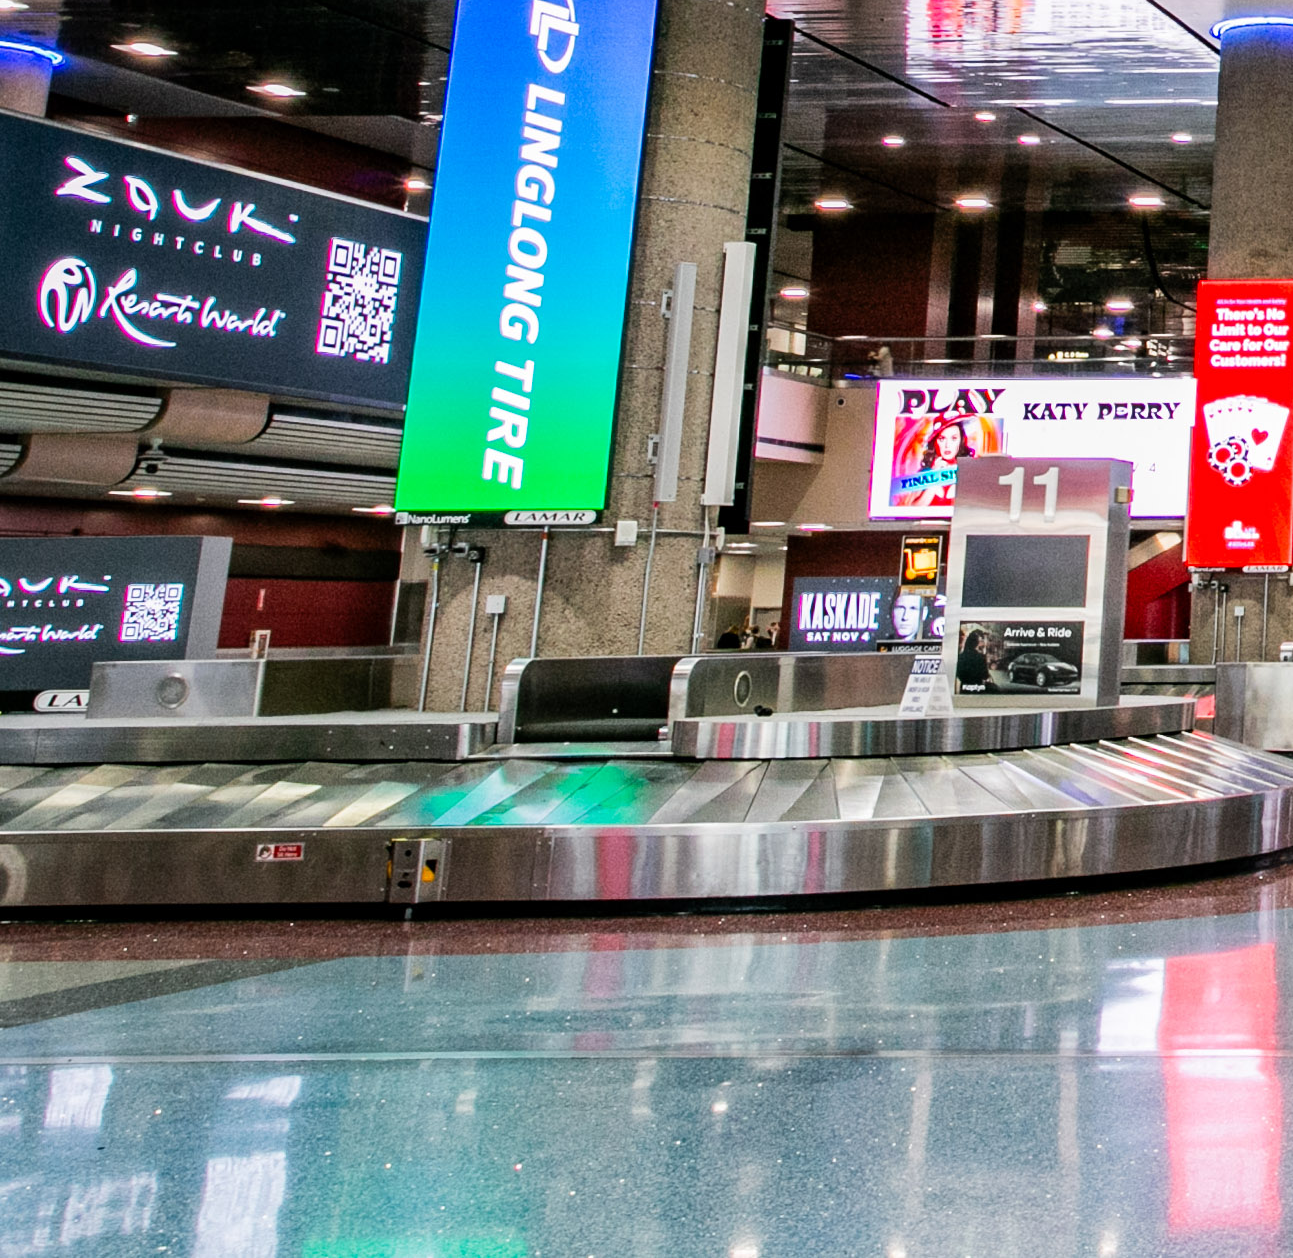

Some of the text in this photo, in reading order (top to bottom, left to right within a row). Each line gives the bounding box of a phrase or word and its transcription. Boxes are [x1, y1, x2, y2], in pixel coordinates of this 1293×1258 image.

[89, 219, 262, 267] NIGHTCLUB
[482, 82, 567, 490] LINGLONG TIRE
[99, 268, 287, 348] Resorts World
[1216, 307, 1286, 321] There's No
[1211, 323, 1290, 336] Limit to Our
[1209, 338, 1290, 352] Care for Our
[1210, 354, 1287, 367] Customers!
[898, 388, 1006, 414] PLAY
[1022, 401, 1182, 420] KATY PERRY
[901, 474, 939, 489] FINAL
[998, 467, 1059, 522] 11
[408, 513, 471, 524] NanoLumens
[514, 513, 586, 522] LAMAR
[798, 592, 881, 631] KASKADE
[806, 631, 871, 642] SAT NOV 4
[1004, 627, 1072, 638] Arrive & Ride
[911, 660, 941, 674] NOTICE
